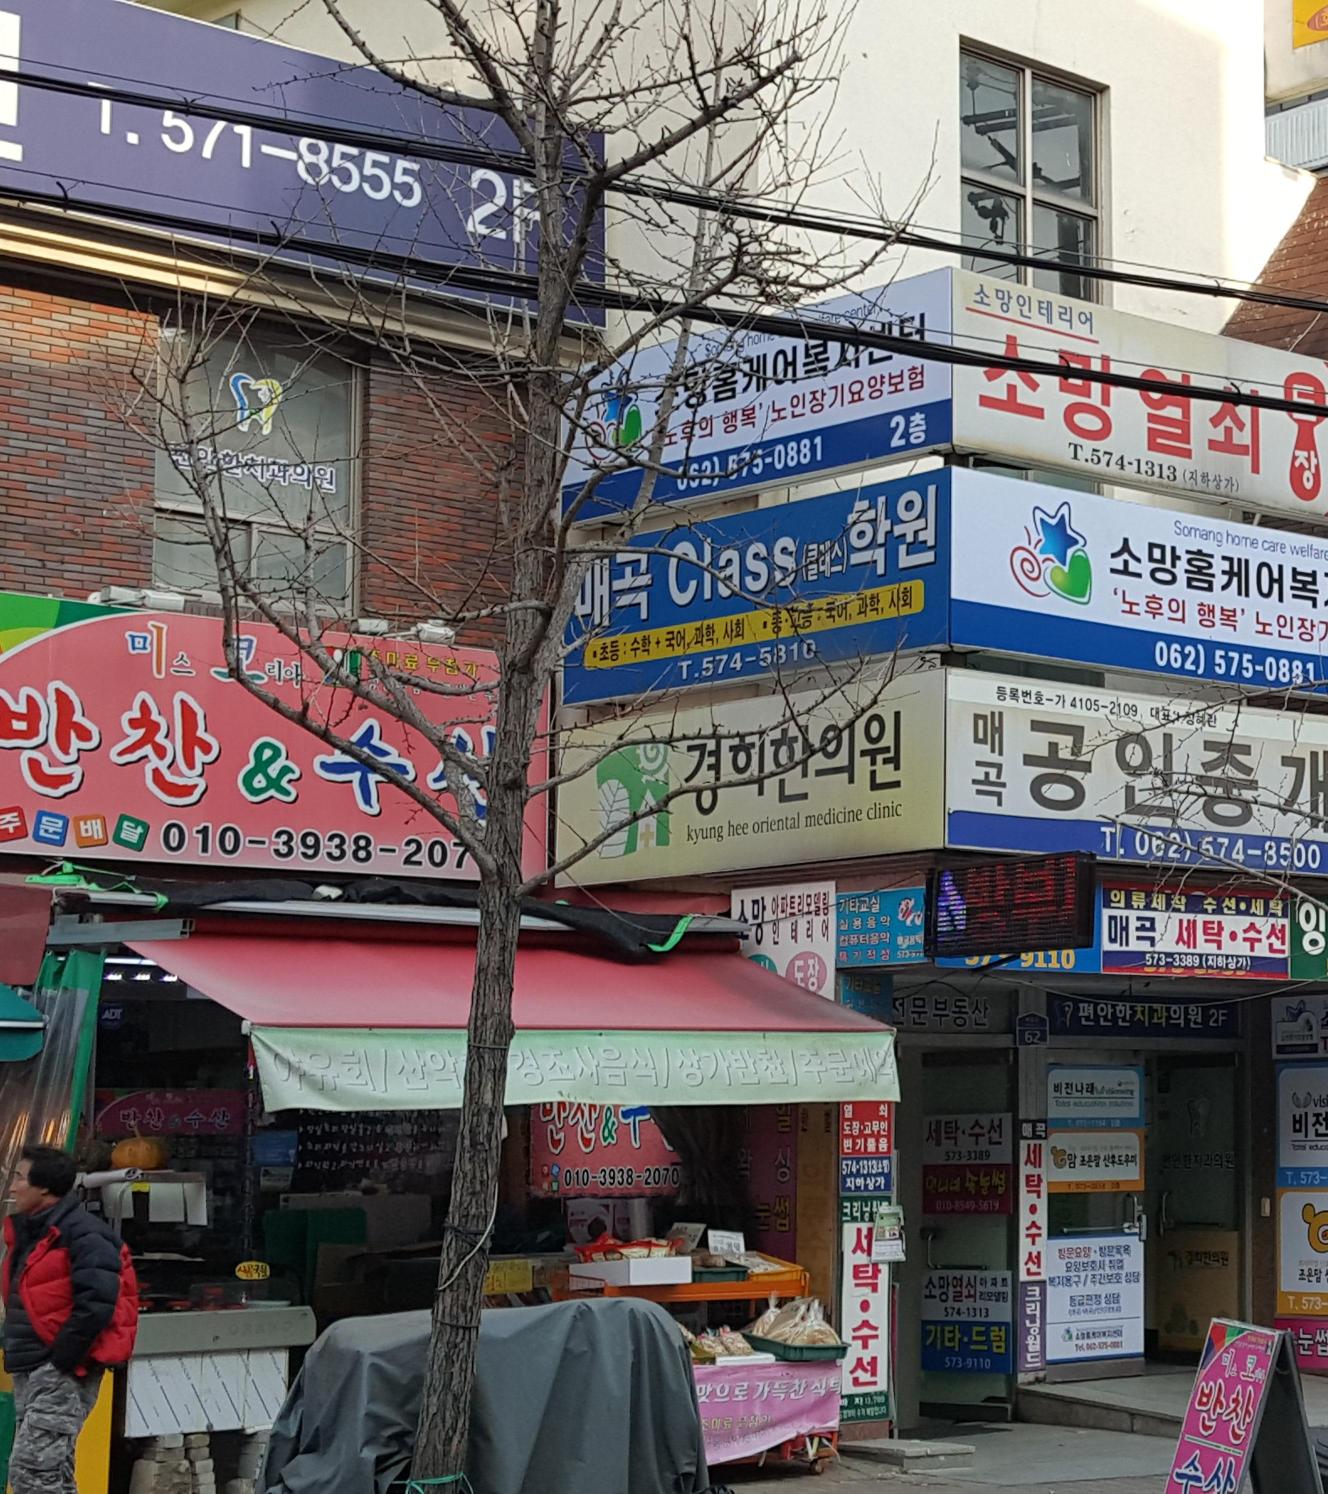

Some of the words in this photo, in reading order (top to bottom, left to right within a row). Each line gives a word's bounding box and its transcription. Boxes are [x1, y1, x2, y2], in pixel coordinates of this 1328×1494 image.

[972, 284, 1094, 334] 소망인테리어
[770, 363, 926, 424] 노인장기요양보험
[889, 411, 928, 449] 2층
[1068, 440, 1179, 483] T.574-1313
[1182, 467, 1240, 493] (지하상가)
[1174, 519, 1223, 547] Somang
[1225, 528, 1259, 551] home
[1261, 537, 1287, 556] care
[1155, 640, 1205, 676] 062)
[1214, 650, 1316, 687] 575-0881
[0, 680, 220, 806] 반찬
[239, 734, 303, 804] &
[684, 710, 903, 816] 경희한의원
[971, 710, 1008, 808] 매곡
[686, 820, 724, 844] kyung
[728, 819, 750, 838] hee
[752, 813, 801, 835] oriental
[804, 807, 864, 830] medicine
[866, 800, 903, 823] clinic
[161, 821, 472, 871] 010-3938-207
[1107, 913, 1158, 949] 매곡
[792, 956, 820, 989] 도장
[1145, 952, 1200, 969] 573-3389
[1201, 952, 1252, 973] (지하상가)
[1079, 1001, 1204, 1029] 편안한치과의원
[1208, 1008, 1229, 1028] 2F
[1024, 1030, 1042, 1045] 62
[944, 1150, 991, 1162] 573-3389
[563, 1166, 681, 1189] 010-3938-2070
[944, 1306, 990, 1318] 574-1313
[1195, 1379, 1257, 1445] 반찬
